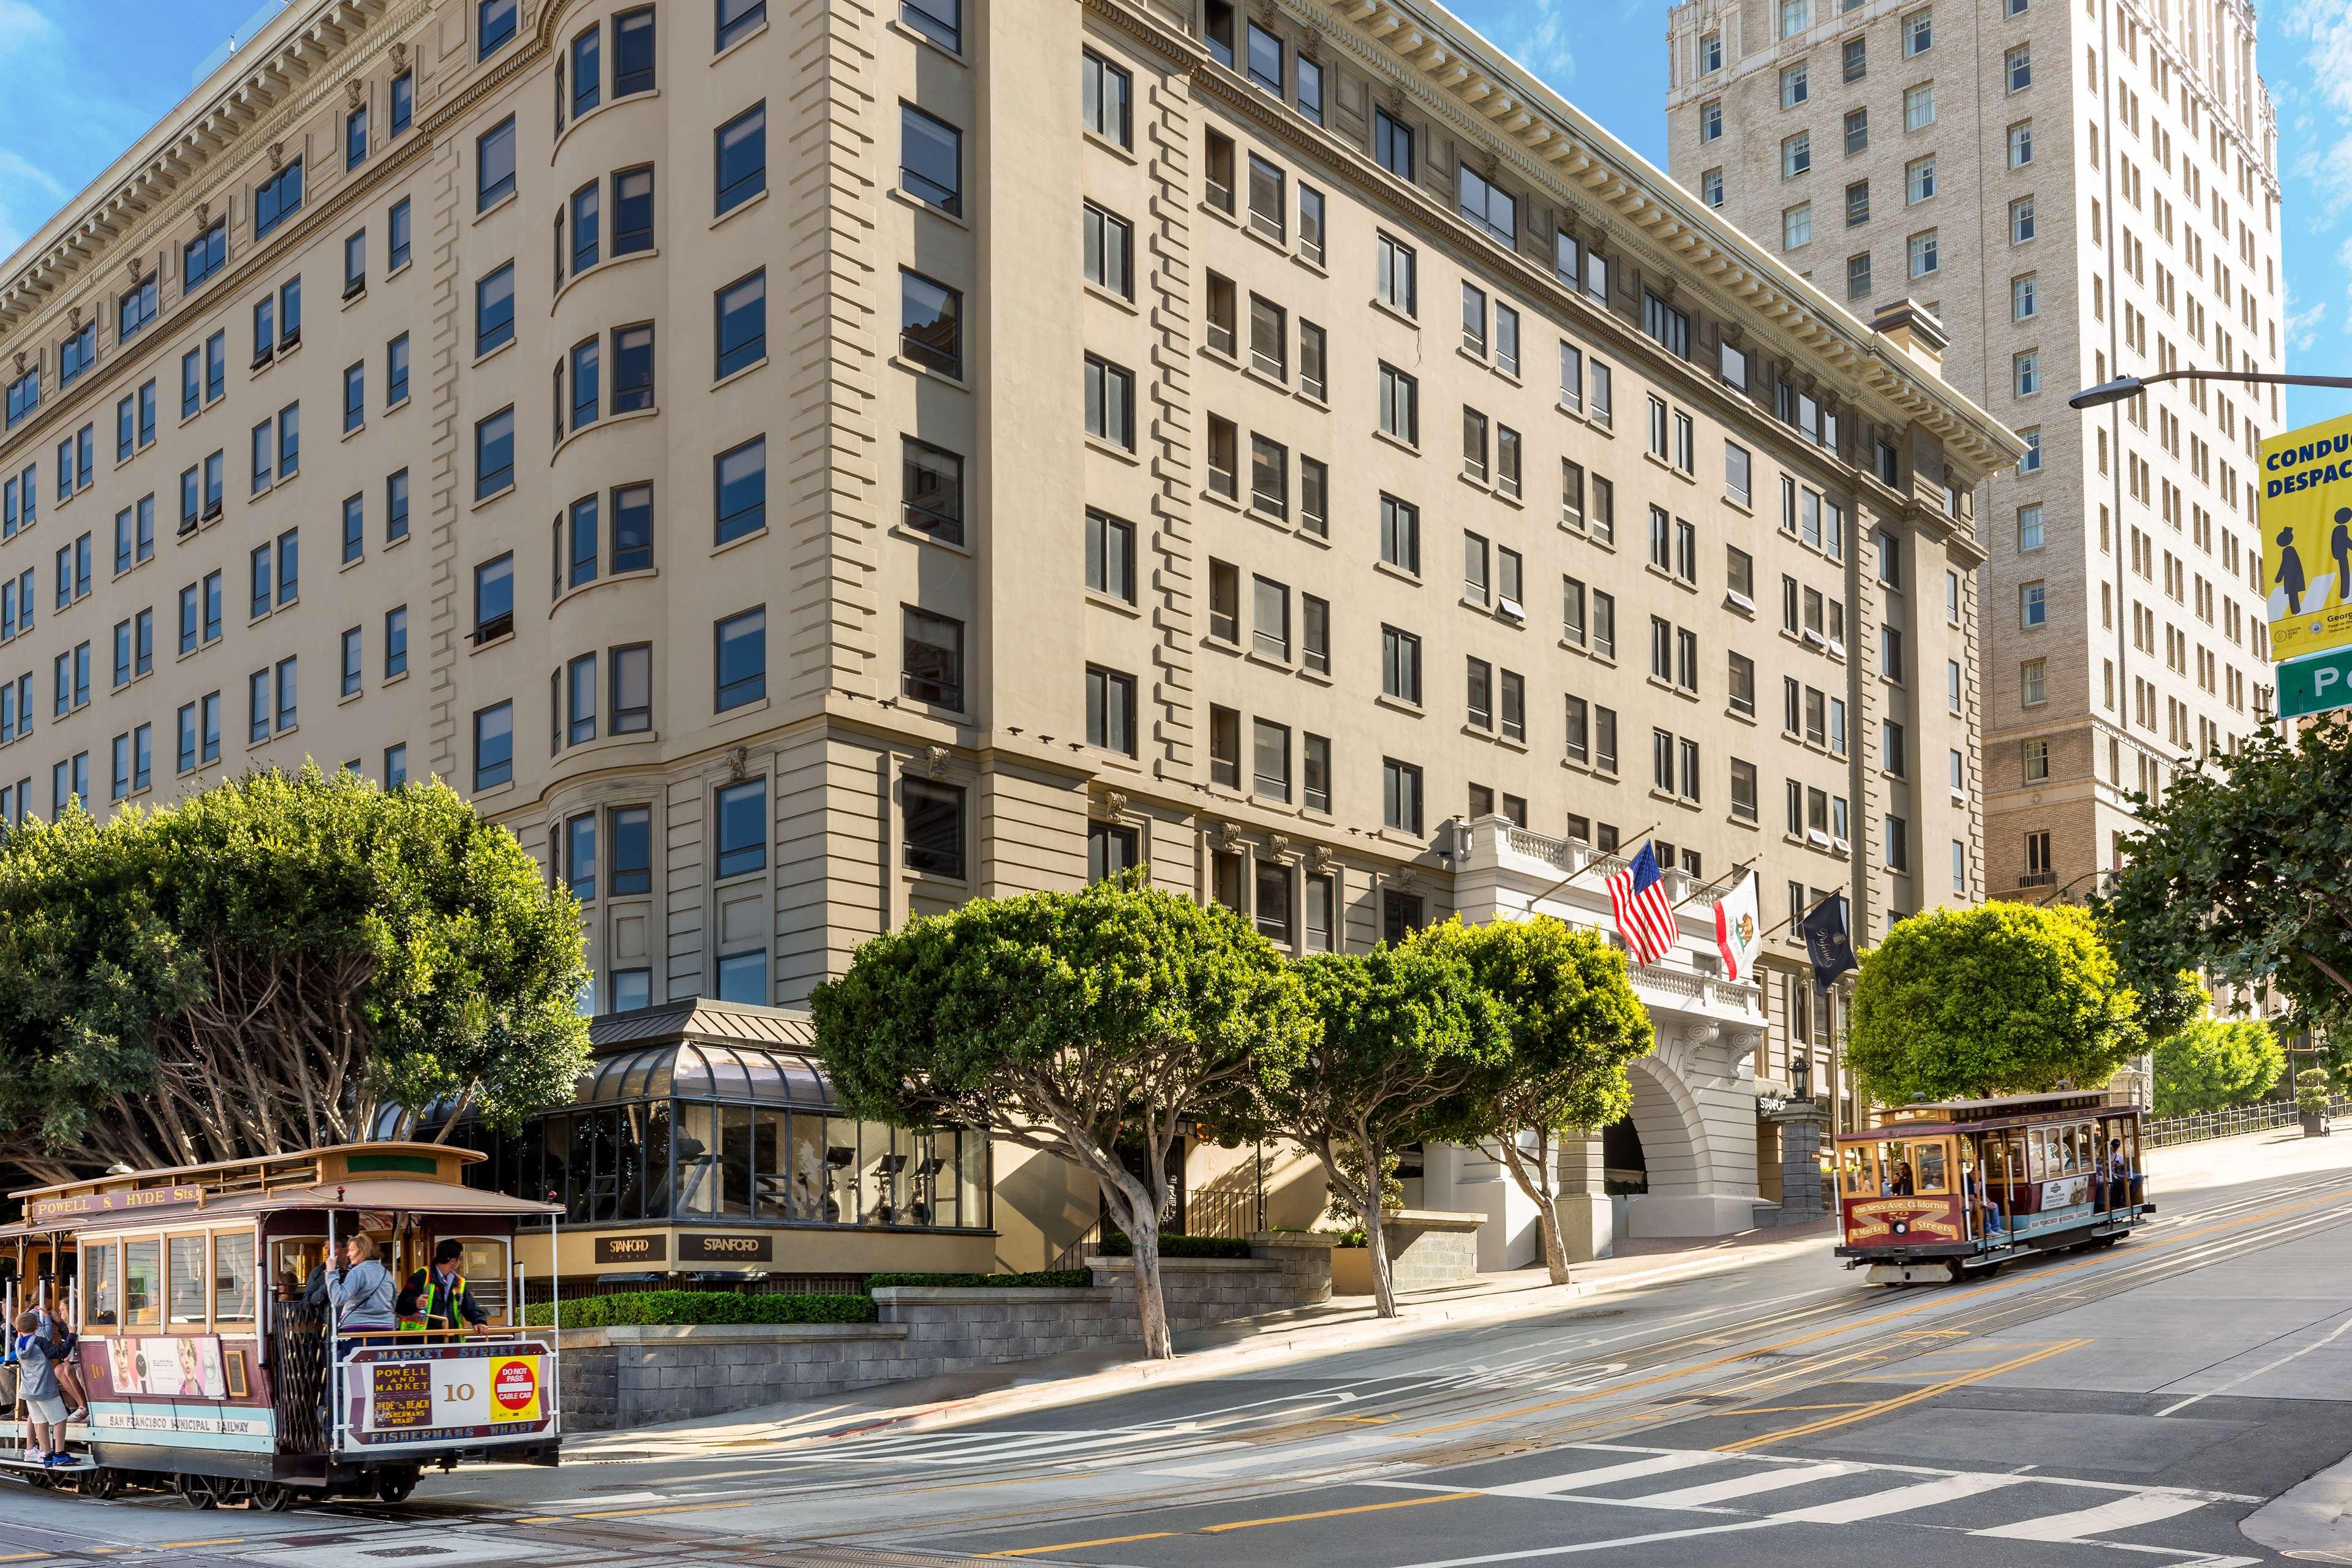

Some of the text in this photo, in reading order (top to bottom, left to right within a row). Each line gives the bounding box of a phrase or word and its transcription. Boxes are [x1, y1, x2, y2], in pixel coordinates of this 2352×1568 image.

[2267, 433, 2352, 471] CONDU
[2267, 459, 2352, 499] DESPAC
[39, 1188, 195, 1215] POWELL & HYDE Sts.
[1907, 1200, 1949, 1210] California
[1888, 1211, 1909, 1220] 52
[1858, 1225, 1886, 1236] Market
[1917, 1221, 1952, 1232] Streets
[610, 1239, 649, 1253] STANFORD
[704, 1238, 759, 1251] STANFORD
[377, 1349, 443, 1361] MARKET
[459, 1345, 516, 1359] STREET
[91, 1364, 105, 1379] 10
[376, 1367, 427, 1378] POWELL
[375, 1382, 428, 1392] MARKET
[443, 1383, 475, 1402] 10
[406, 1399, 429, 1409] BEACH
[382, 1410, 425, 1419] FISHERMANS
[110, 1415, 124, 1426] SAN
[127, 1416, 167, 1429] FRANCISCO
[170, 1418, 210, 1431] MUNICIPAL
[369, 1422, 536, 1444] FISHERMANS WHARF
